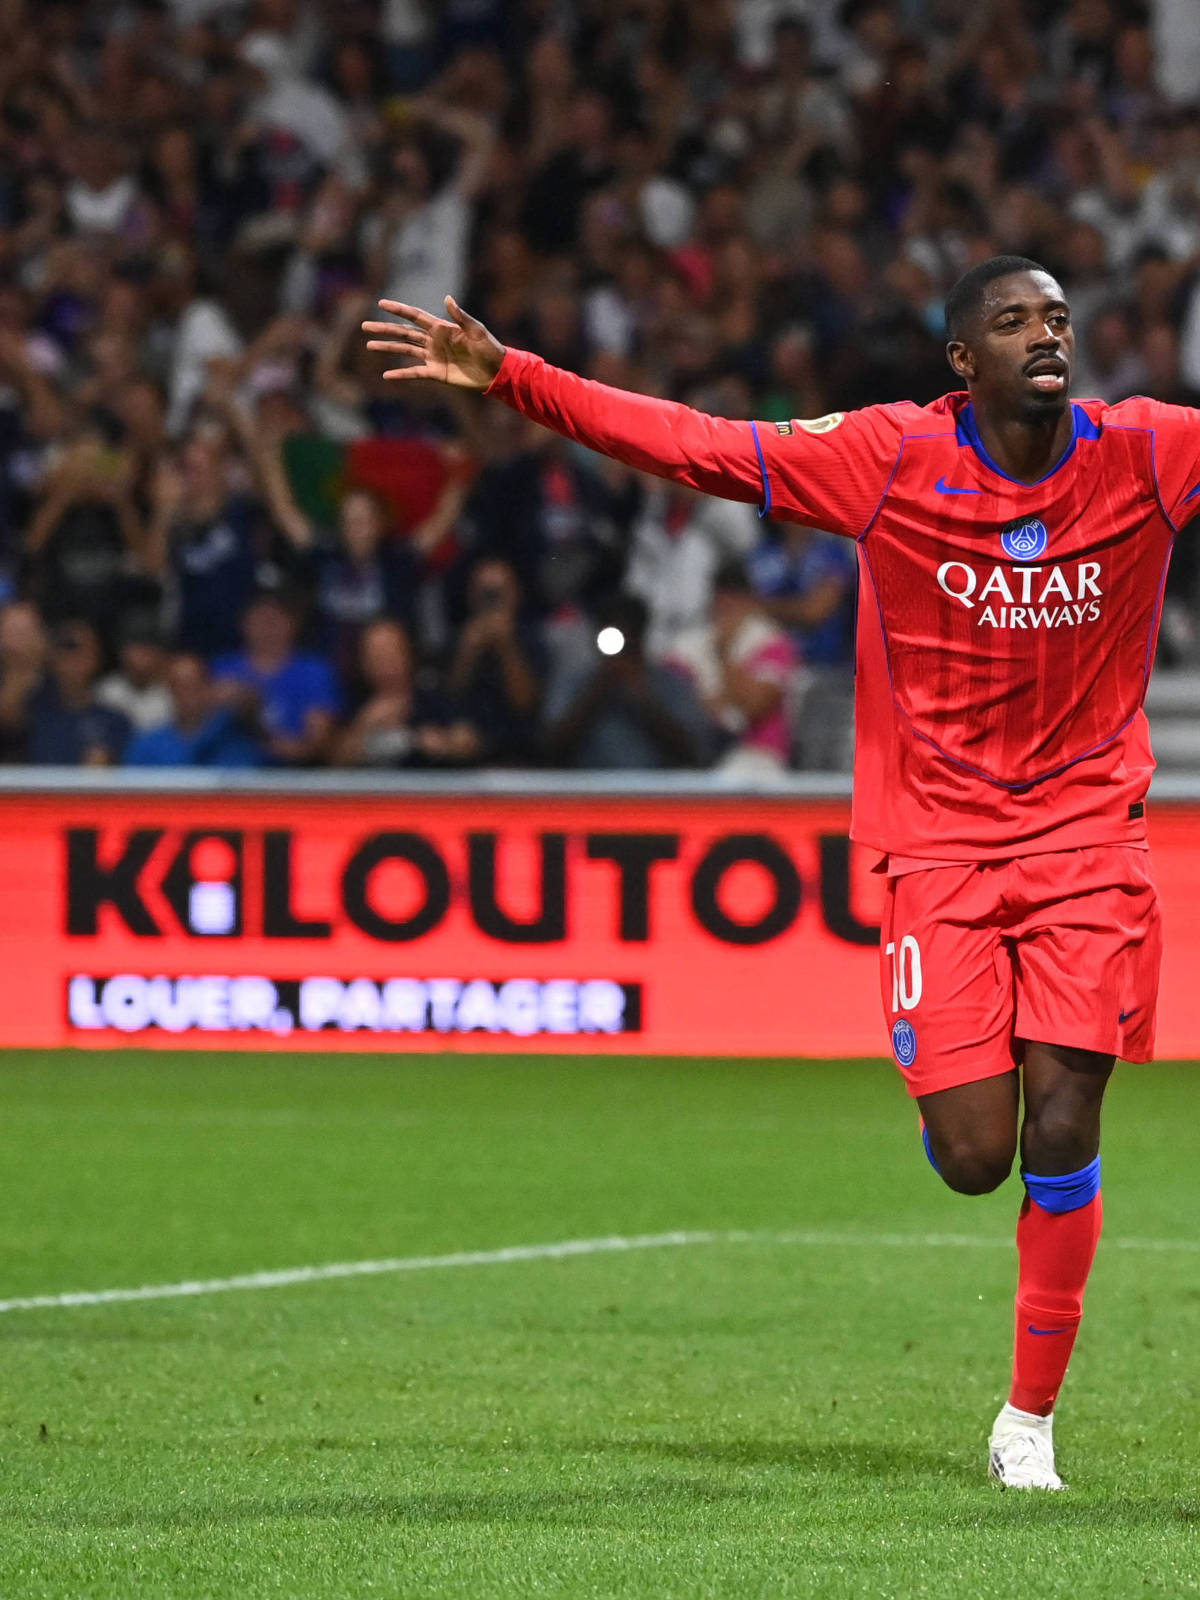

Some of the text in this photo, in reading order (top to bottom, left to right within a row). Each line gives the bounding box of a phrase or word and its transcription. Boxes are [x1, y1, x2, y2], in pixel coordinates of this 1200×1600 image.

[936, 560, 1104, 609] QATAR
[977, 599, 1101, 629] AIRWAYS
[886, 934, 923, 1013] 10
[68, 974, 627, 1038] LOUER, PARTAGER
